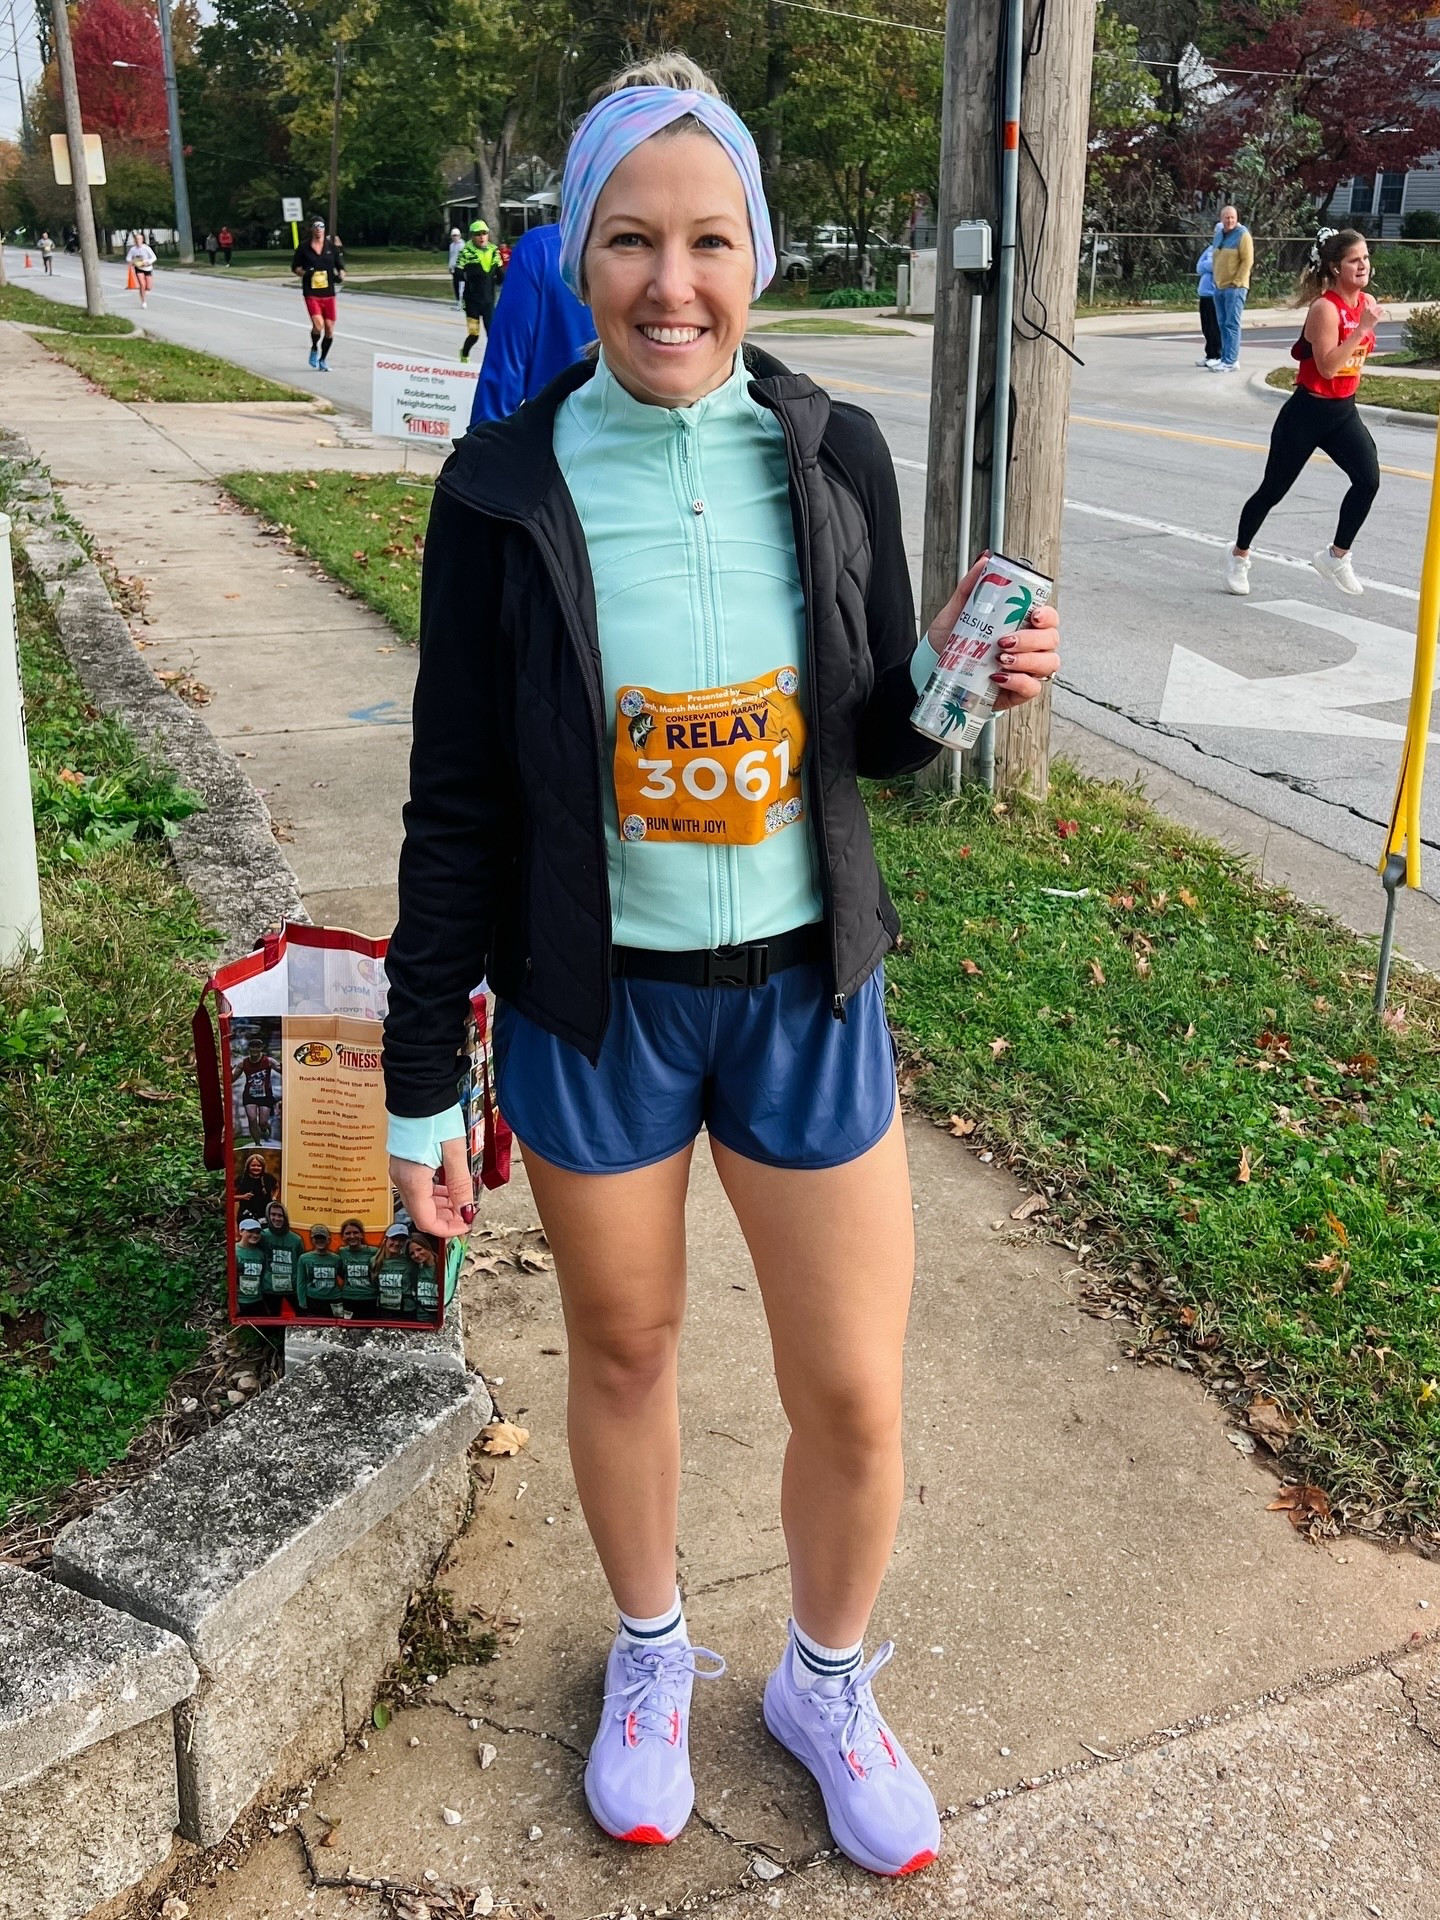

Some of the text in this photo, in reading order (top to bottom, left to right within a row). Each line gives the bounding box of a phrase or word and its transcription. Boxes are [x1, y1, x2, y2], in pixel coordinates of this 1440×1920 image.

[376, 361, 404, 371] GOOD
[405, 365, 430, 374] LUCK
[410, 374, 445, 385] from the
[404, 388, 450, 400] Robberson
[396, 398, 457, 412] Neighborhood
[408, 419, 444, 435] FITNESS
[959, 611, 995, 636] CELSIUS
[659, 703, 686, 713] Marsh
[687, 700, 730, 712] McLennan
[731, 693, 759, 706] Agency
[687, 687, 741, 703] Presented by
[665, 700, 769, 723] CONSERVATION MARATHON
[665, 708, 769, 750] RELAY
[637, 739, 790, 801] 3061
[646, 816, 727, 834] RUN WITH JOY!
[339, 1050, 378, 1069] FITNESS
[299, 1075, 336, 1083] Rock4Kids
[344, 1089, 357, 1098] Run
[297, 1172, 332, 1180] Presented
[298, 1194, 329, 1202] Dogwood
